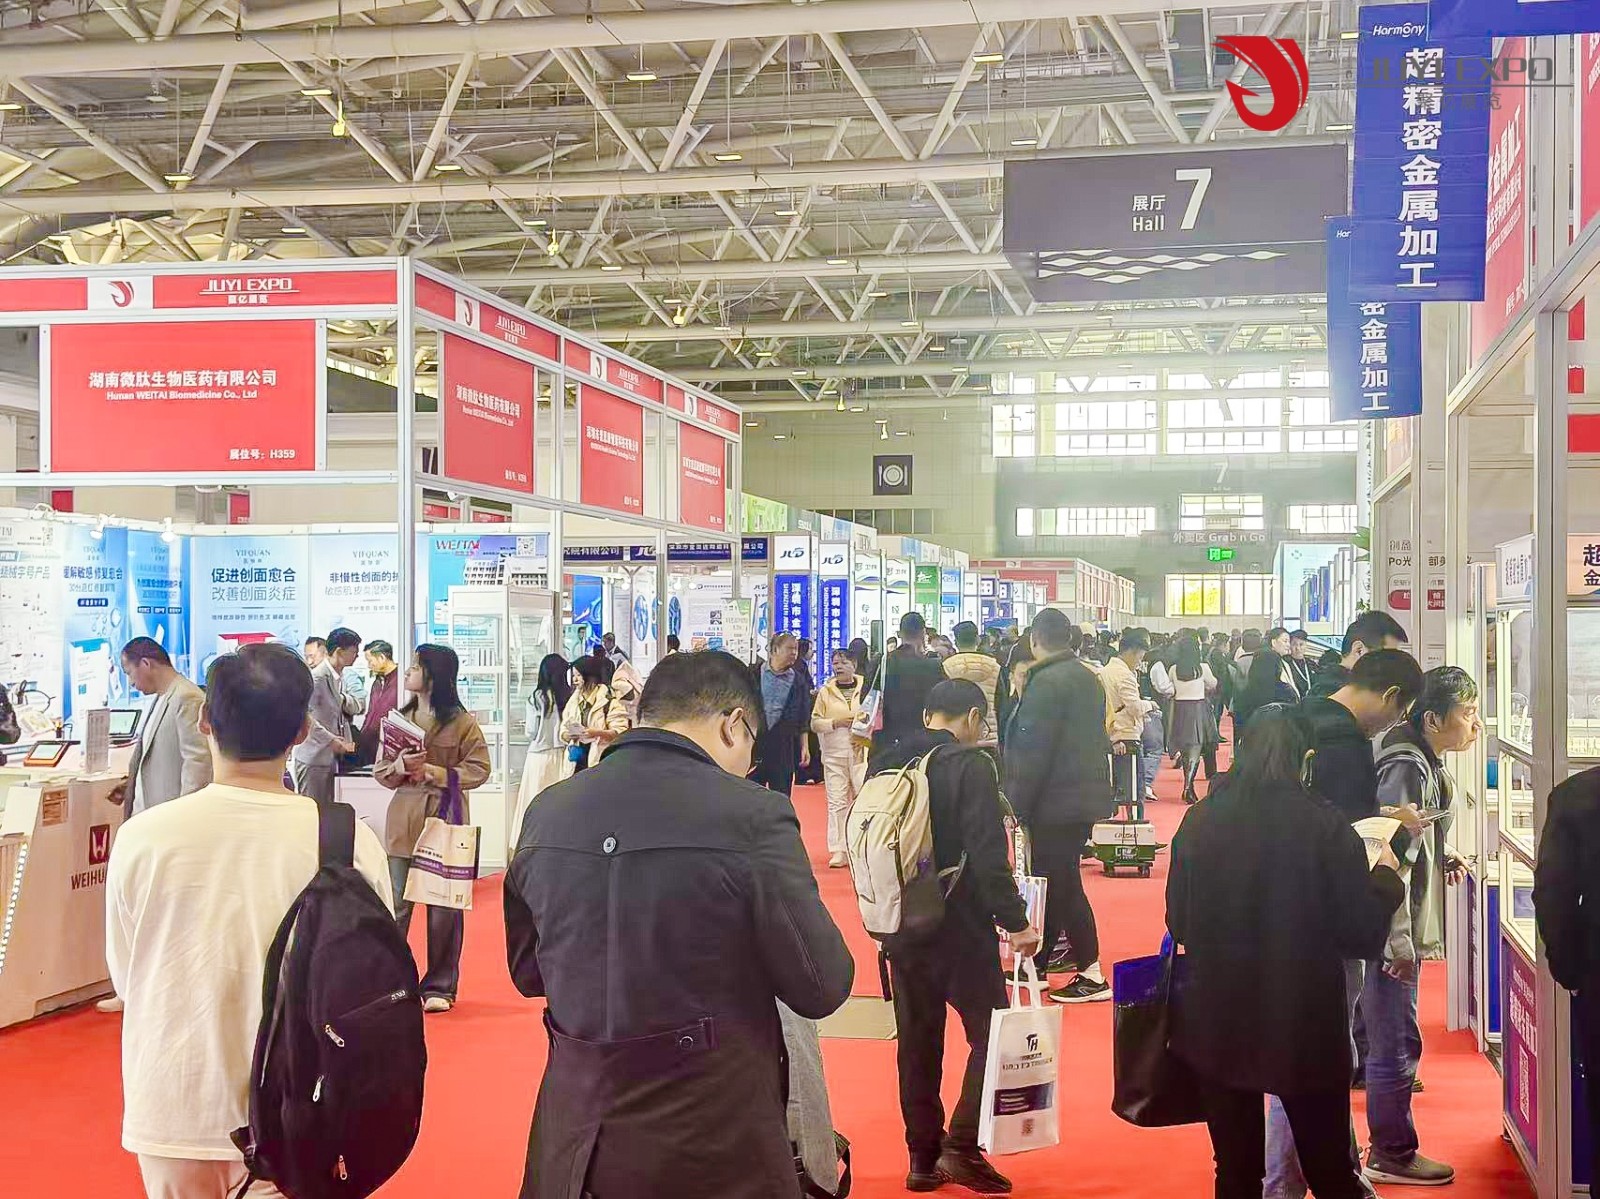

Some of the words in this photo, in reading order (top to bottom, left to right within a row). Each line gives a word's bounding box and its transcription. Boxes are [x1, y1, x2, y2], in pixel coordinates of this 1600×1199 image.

[1372, 22, 1426, 38] Harmony
[1396, 47, 1445, 290] 超精密金属加工
[1132, 195, 1166, 212] 展厅
[1174, 167, 1213, 231] 7
[1132, 215, 1164, 231] Hall
[202, 279, 242, 292] JUYI
[246, 277, 293, 291] EXPO
[88, 369, 277, 388] 湖南微肽生物医药有限公司
[106, 390, 134, 401] Hunan
[136, 390, 168, 400] WEITAI
[169, 389, 222, 400] Biomedicine
[242, 389, 258, 399] Ltd
[1213, 462, 1229, 484] 7
[1208, 532, 1237, 543] Grab
[1249, 533, 1266, 543] Go
[211, 567, 297, 583] 促进创面愈合
[211, 585, 297, 602] 改善创面炎症
